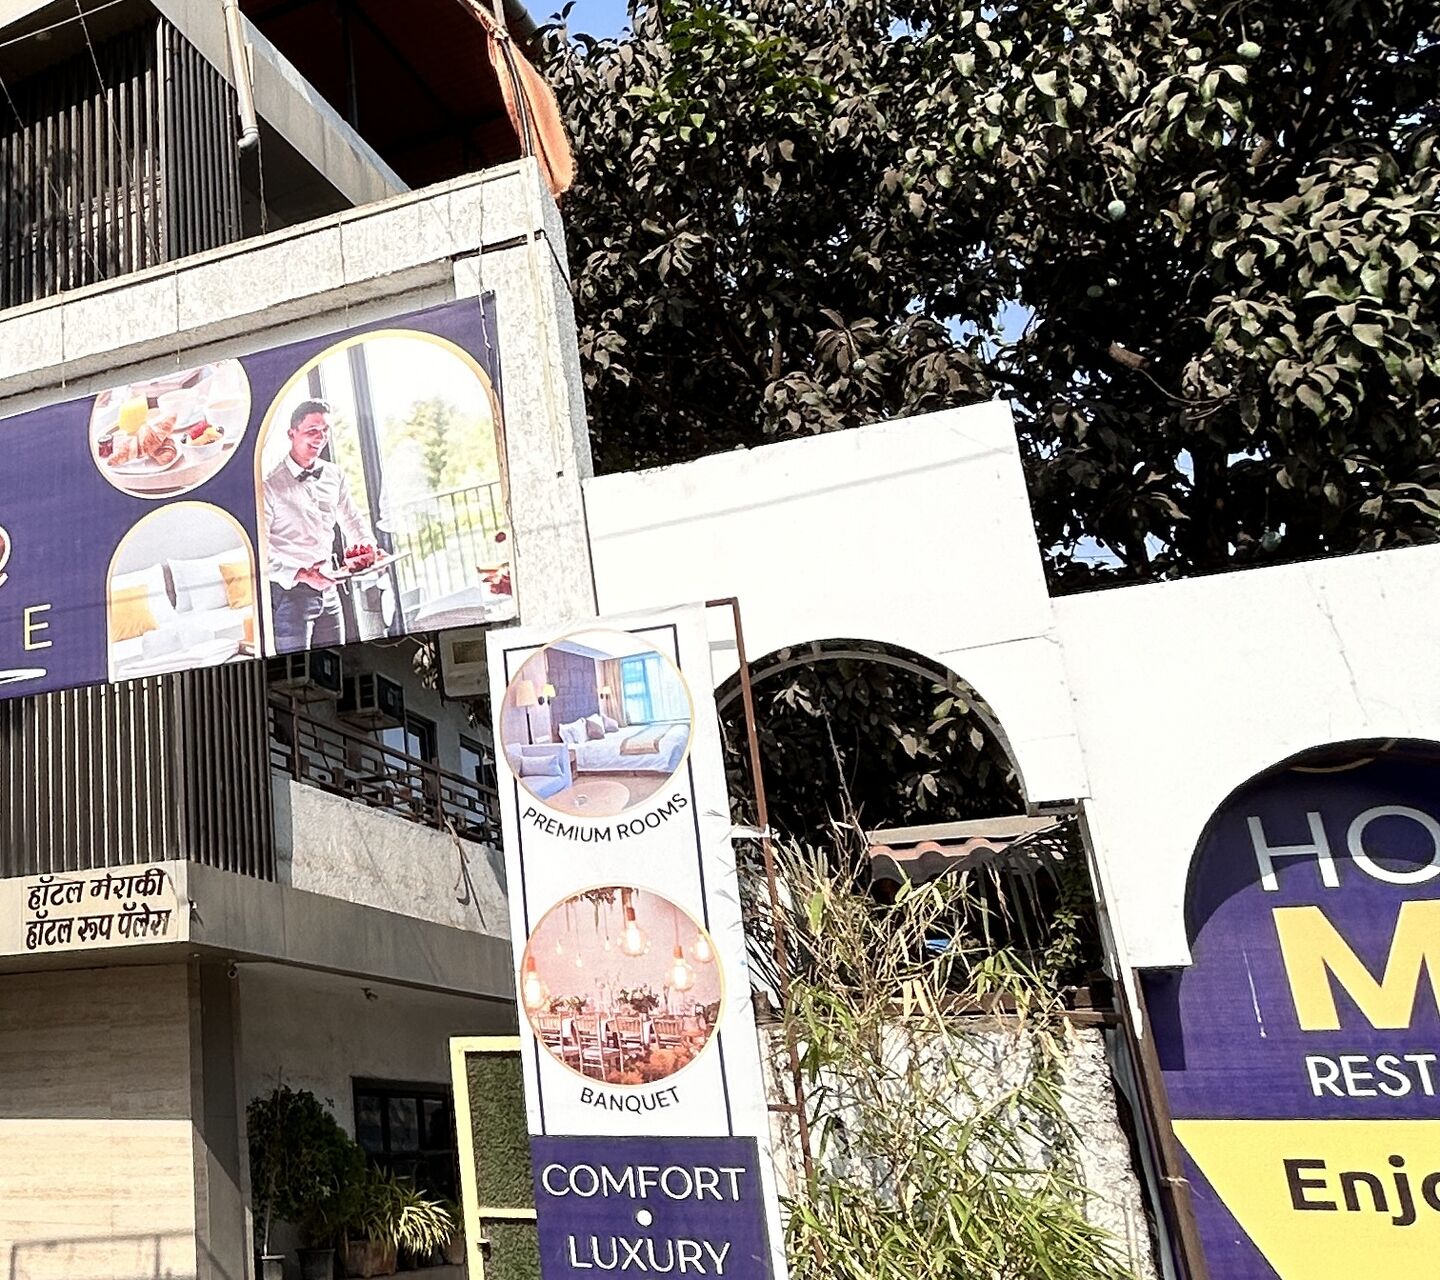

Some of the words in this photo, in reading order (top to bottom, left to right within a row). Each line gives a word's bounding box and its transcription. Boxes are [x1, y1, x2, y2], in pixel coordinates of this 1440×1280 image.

[521, 805, 612, 843] PREMIUM
[616, 792, 689, 838] ROOMS
[27, 875, 86, 910] हॉटल
[26, 909, 75, 950] हॉटल
[77, 914, 115, 942] रूप
[1305, 1053, 1437, 1097] REST
[580, 1084, 682, 1114] BANQUET
[541, 1162, 747, 1202] COMFORT
[567, 1234, 731, 1276] LUXURY
